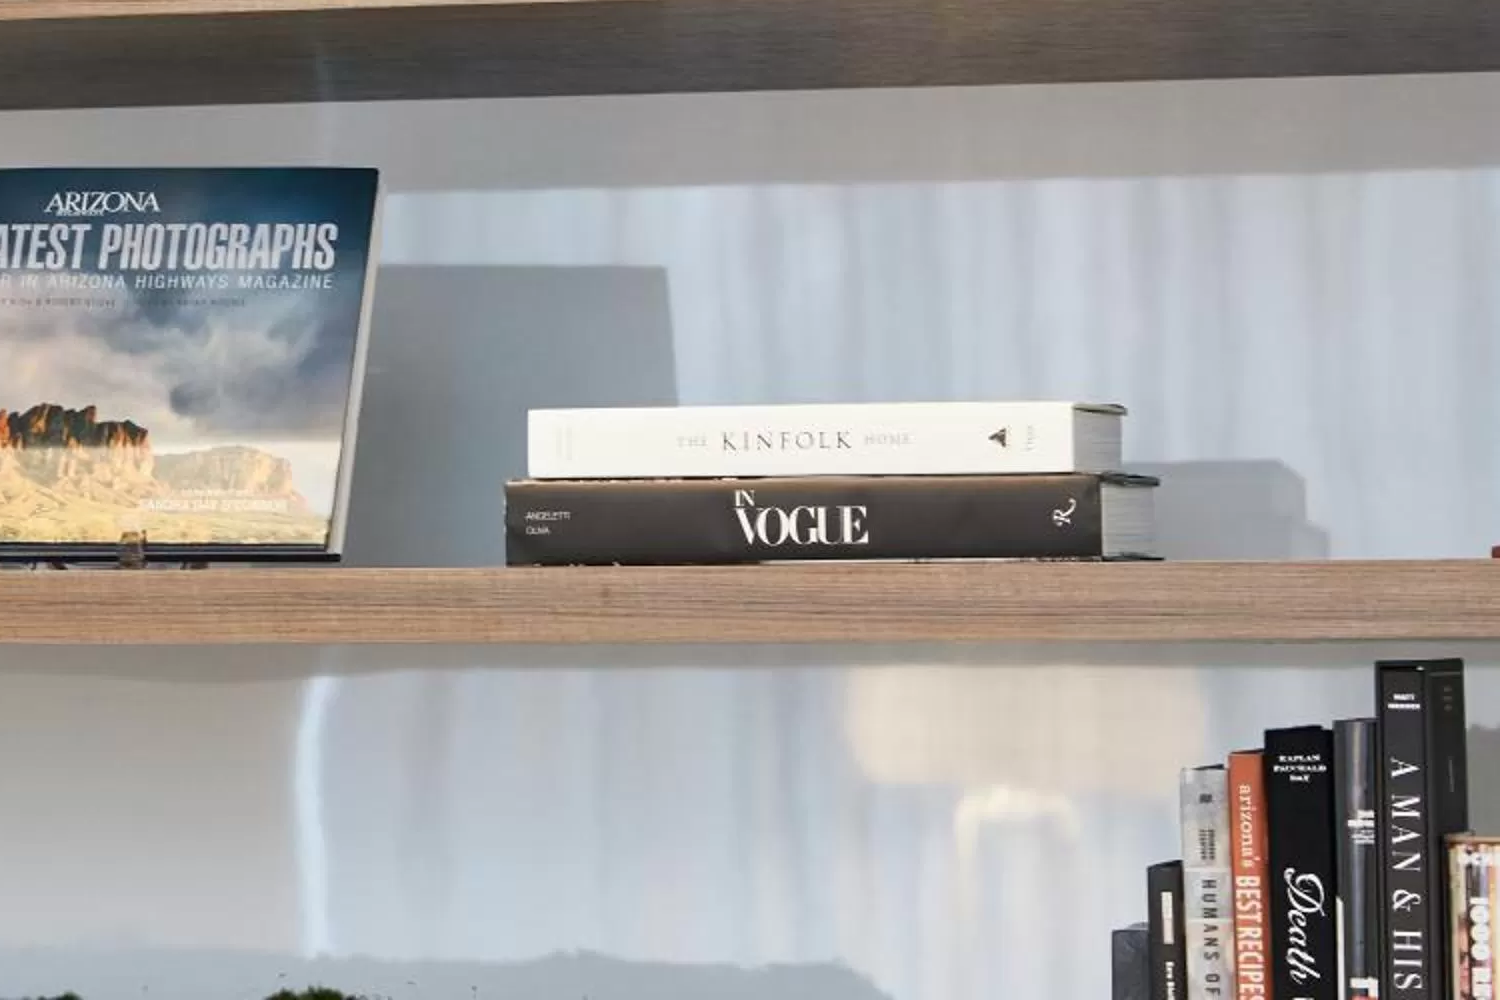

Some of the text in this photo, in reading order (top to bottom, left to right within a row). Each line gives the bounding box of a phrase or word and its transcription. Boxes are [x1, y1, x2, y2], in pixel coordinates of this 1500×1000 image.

[43, 191, 162, 214] ARIZONA
[97, 222, 339, 271] PHOTOGRAPHS
[20, 273, 38, 288] IN
[48, 273, 126, 289] ARIZONA
[134, 273, 229, 289] HIGHWAYS
[238, 273, 335, 289] MAGAZINE
[676, 435, 708, 448] THE
[721, 431, 853, 451] KINFOLK
[734, 489, 756, 507] IN
[733, 505, 870, 546] VOGUE
[1390, 756, 1423, 990] A MAN & HIS
[1201, 879, 1219, 961] HUMANS
[1235, 875, 1262, 923] BEST
[1284, 867, 1326, 985] Death
[1469, 896, 1491, 961] 1000
[1204, 973, 1221, 997] OF
